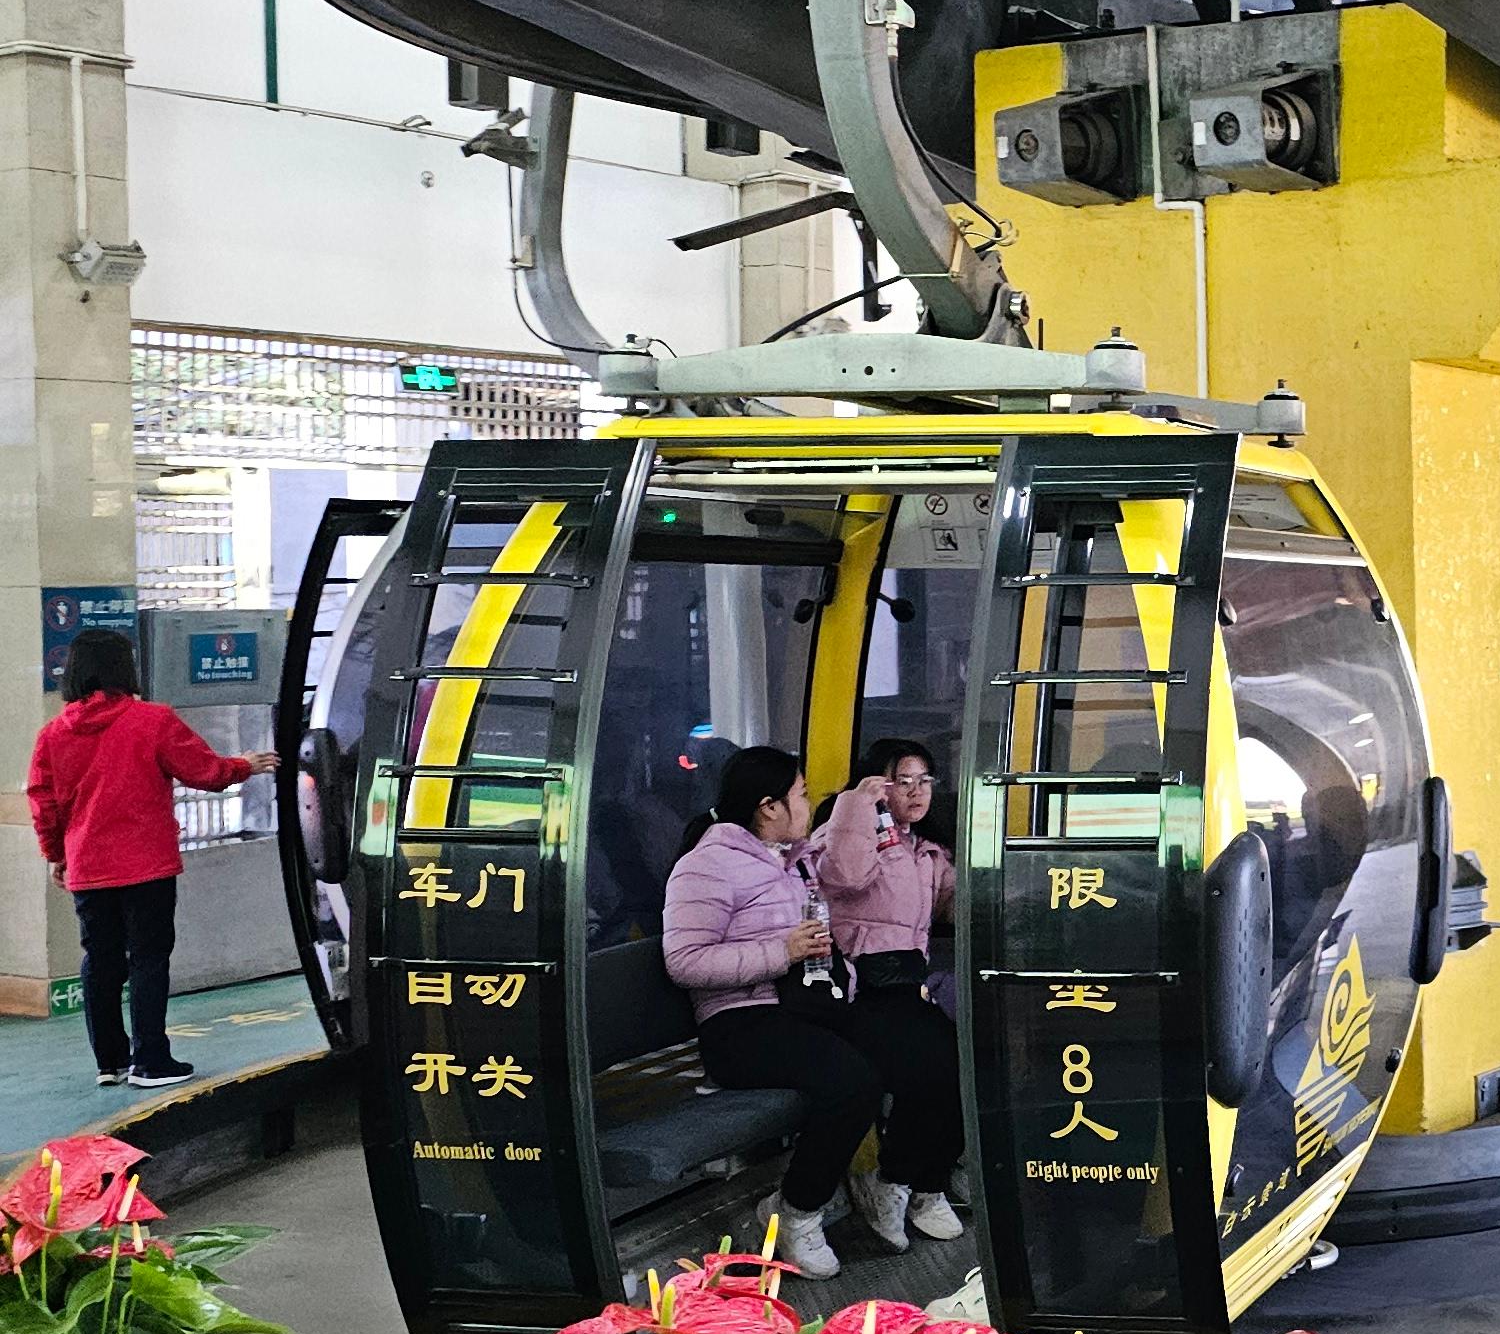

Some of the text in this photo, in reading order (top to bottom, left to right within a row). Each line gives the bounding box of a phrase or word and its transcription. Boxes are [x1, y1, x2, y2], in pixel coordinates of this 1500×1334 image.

[197, 671, 211, 680] No
[399, 862, 526, 913] 车门
[407, 971, 527, 1008] 自动
[404, 1052, 534, 1100] 开关
[412, 1140, 542, 1162] Automatic door
[1026, 1160, 1159, 1185] Eight people only
